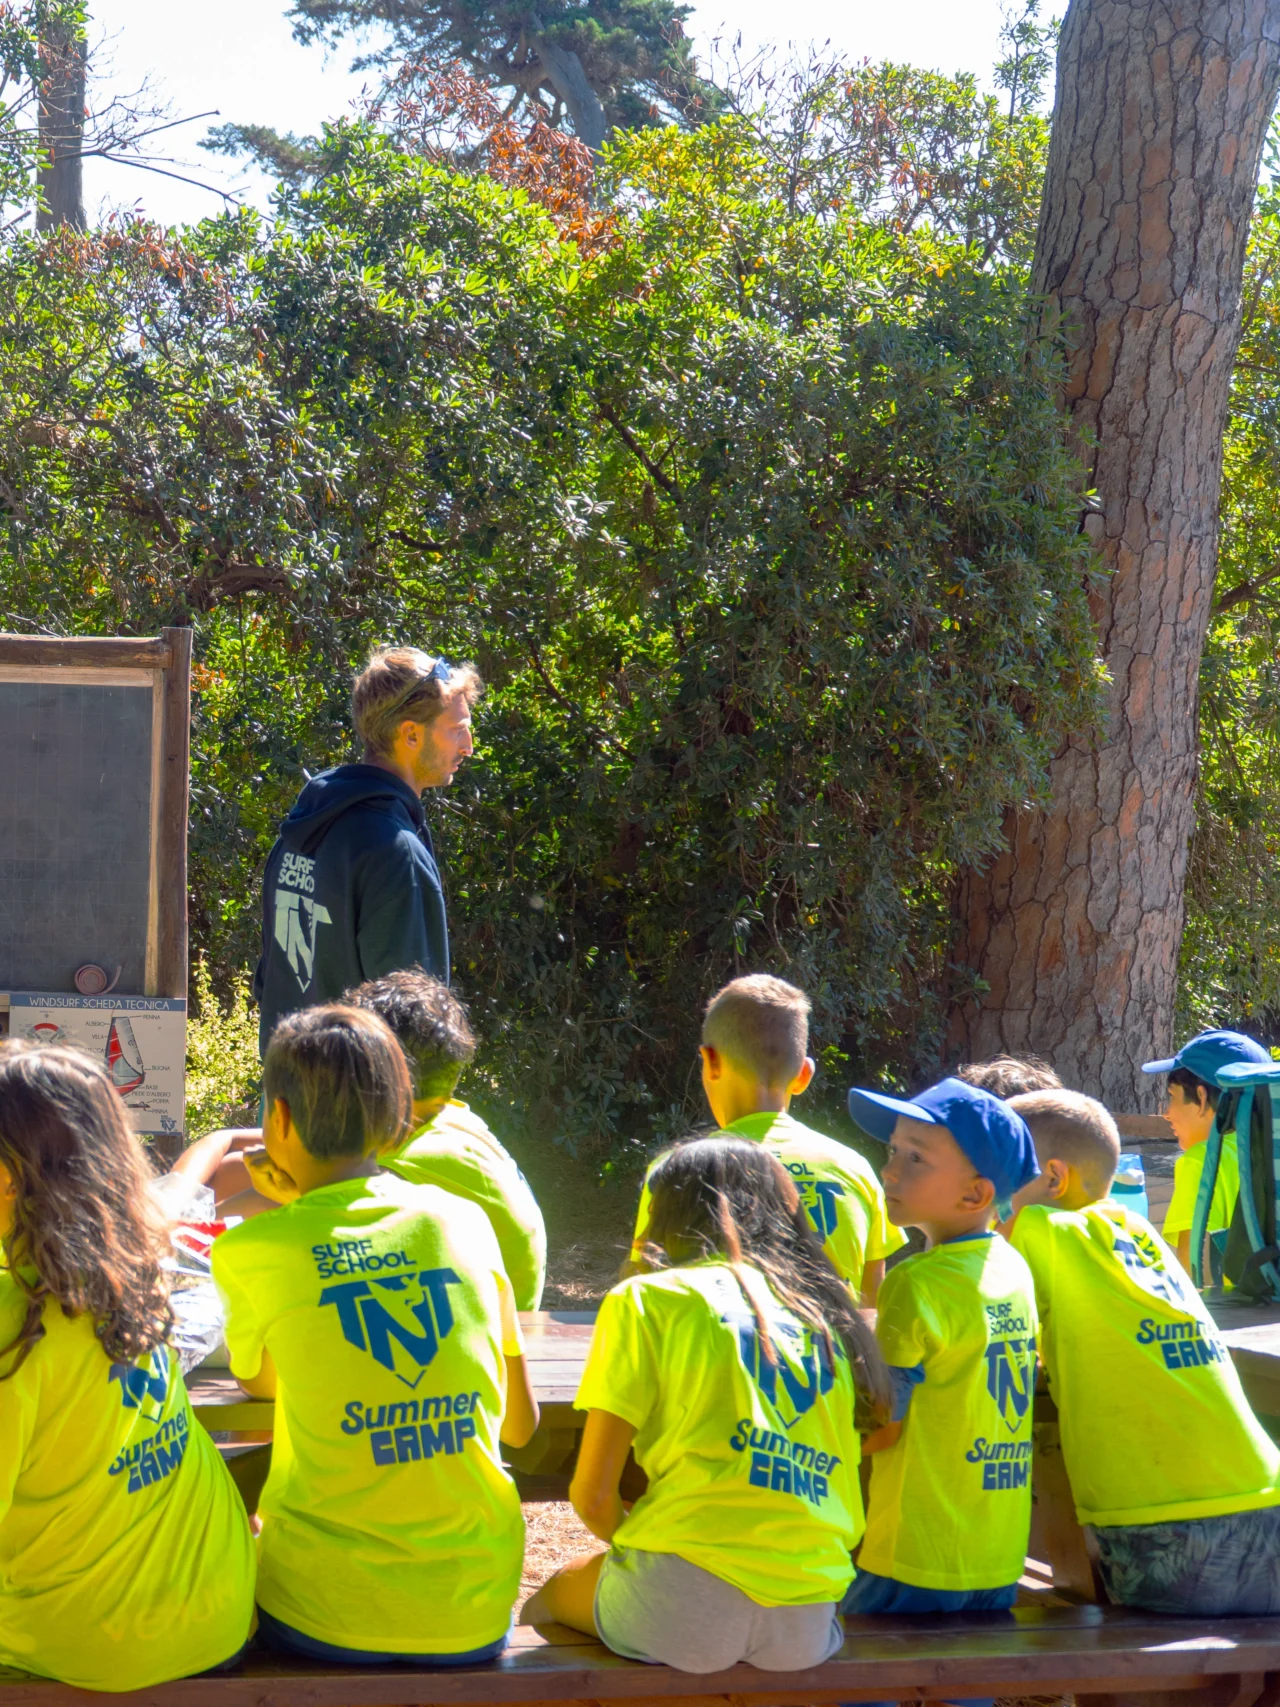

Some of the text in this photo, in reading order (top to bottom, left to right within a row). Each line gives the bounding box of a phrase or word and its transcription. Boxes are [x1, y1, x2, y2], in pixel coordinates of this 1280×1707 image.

[281, 852, 315, 875] SURF
[29, 997, 170, 1010] WINDSURF SCHEDA TECNICA
[311, 1239, 372, 1262] SURF
[316, 1250, 417, 1279] SCHOOL
[318, 1267, 462, 1372] TNT
[986, 1302, 1012, 1320] SURF
[989, 1318, 1027, 1336] SCHOOL
[340, 1391, 482, 1435] Summer
[370, 1417, 476, 1466] CAMP
[730, 1417, 842, 1476] Summer
[749, 1451, 829, 1507] CAMP
[982, 1461, 1031, 1490] CAM
